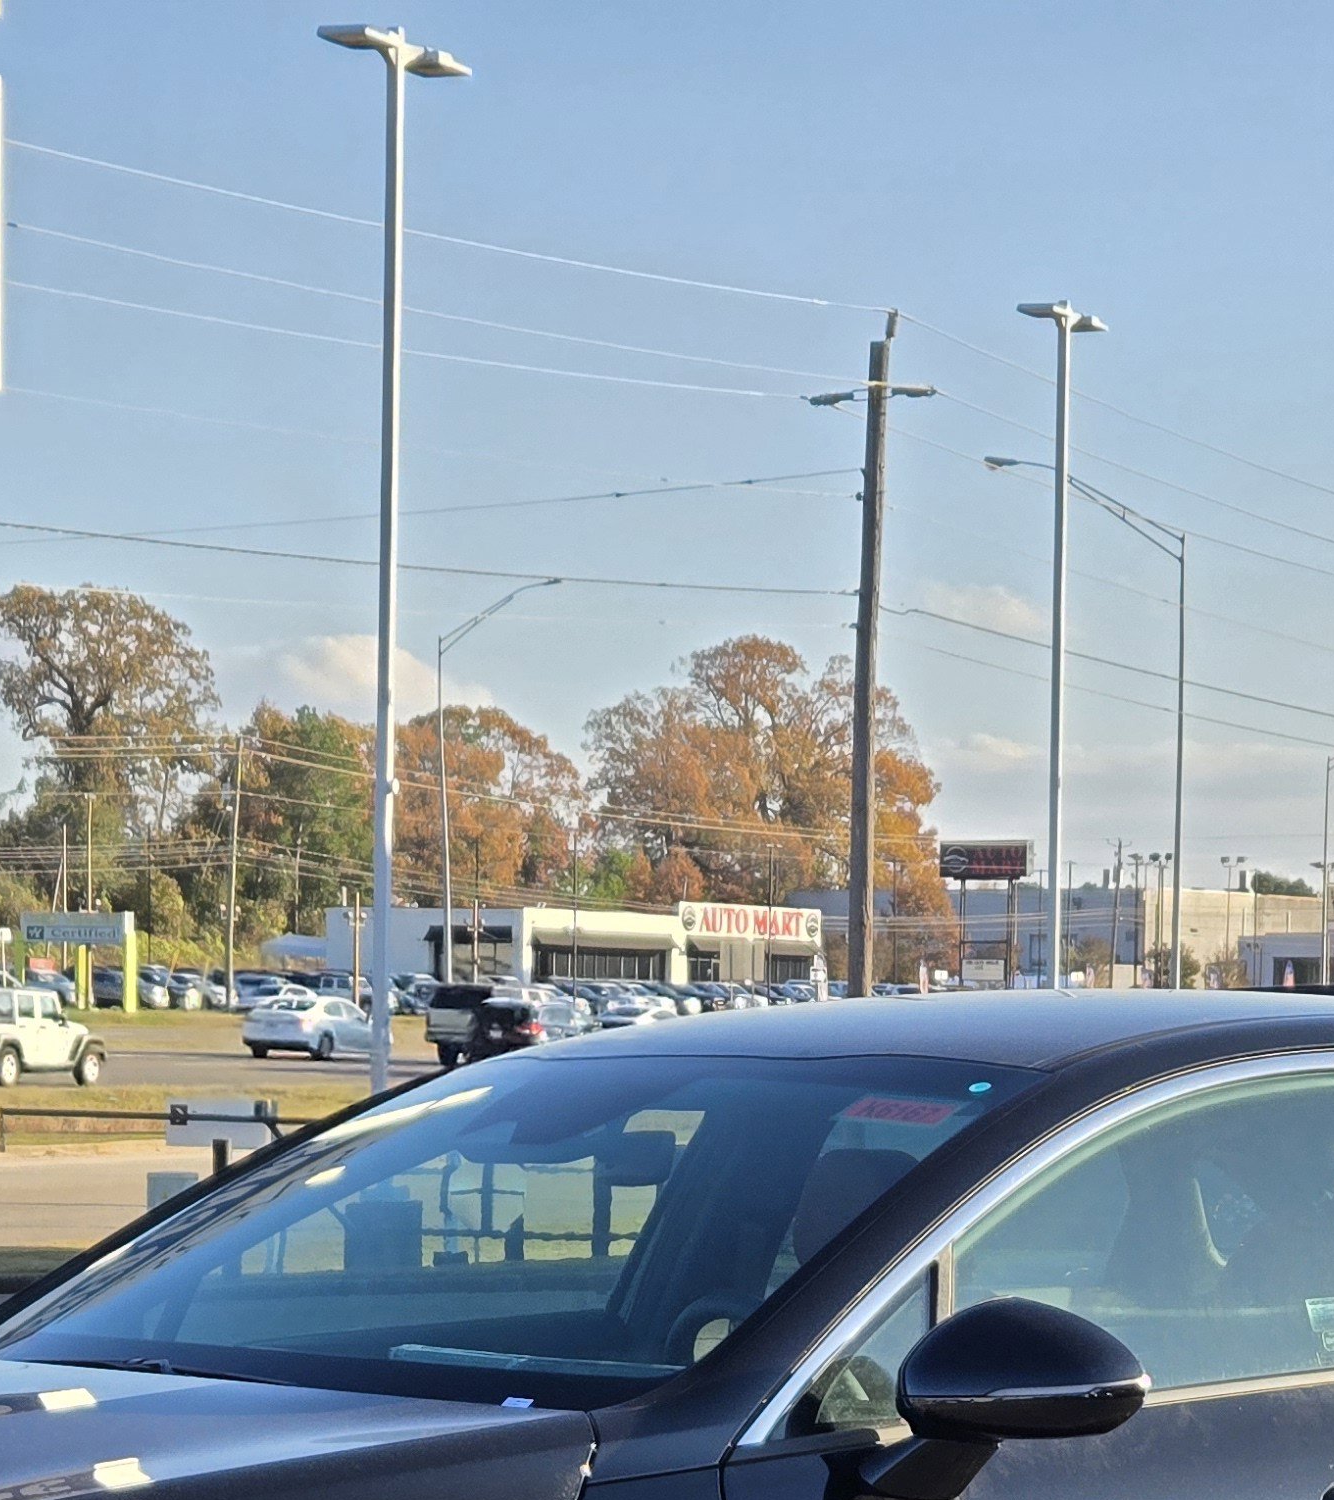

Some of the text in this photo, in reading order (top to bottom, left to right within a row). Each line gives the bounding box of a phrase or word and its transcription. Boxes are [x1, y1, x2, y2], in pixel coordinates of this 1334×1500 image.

[699, 907, 804, 937] AUTO MART
[50, 927, 116, 939] Certified
